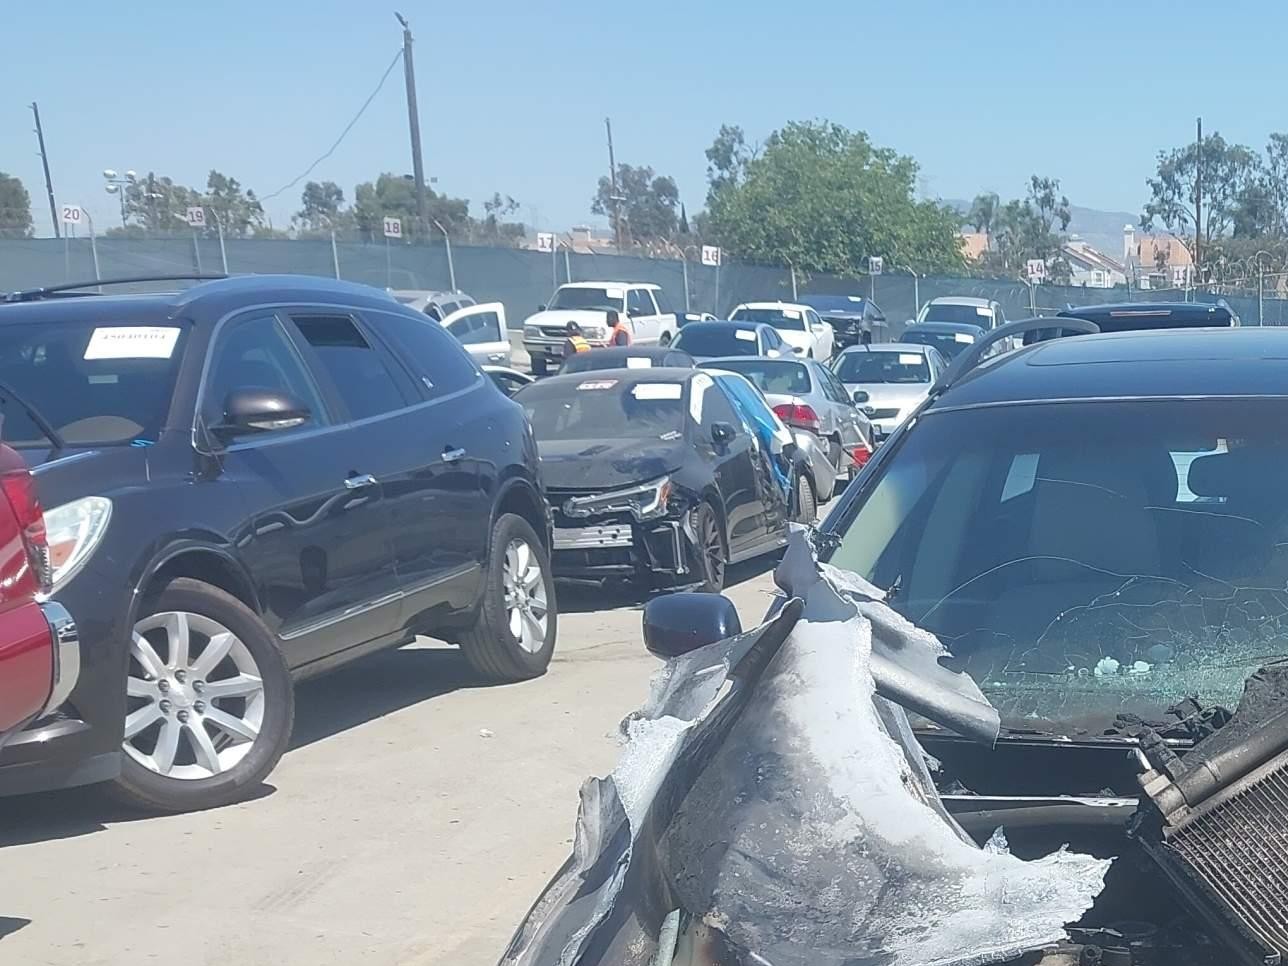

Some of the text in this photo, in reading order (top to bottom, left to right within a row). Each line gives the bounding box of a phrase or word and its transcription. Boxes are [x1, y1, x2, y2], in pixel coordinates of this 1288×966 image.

[64, 208, 80, 220] 20
[189, 210, 203, 223] 19
[385, 222, 400, 234] 18
[539, 237, 553, 249] 17
[870, 261, 881, 272] 15
[1029, 264, 1043, 275] 14
